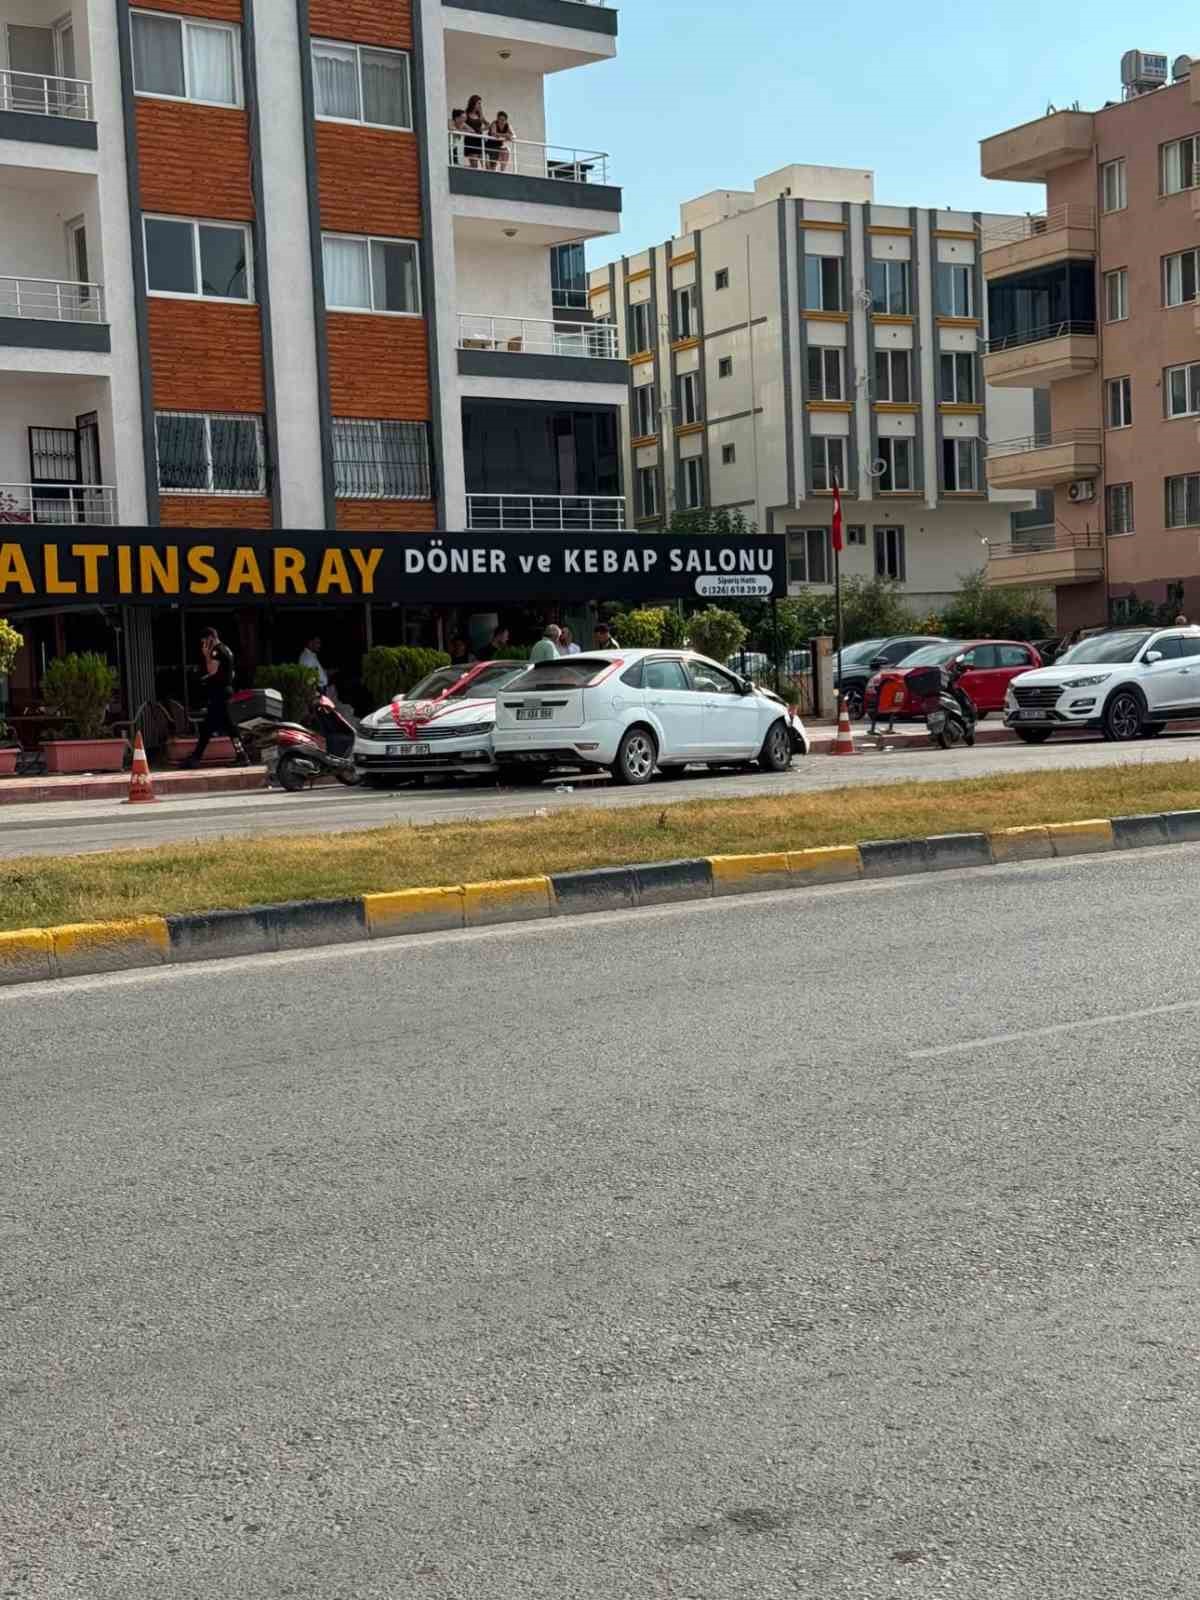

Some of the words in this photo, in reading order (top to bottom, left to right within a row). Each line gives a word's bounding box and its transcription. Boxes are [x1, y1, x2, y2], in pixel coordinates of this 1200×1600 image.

[0, 543, 384, 594] ALTINSARAY
[404, 539, 507, 574] DÖNER
[518, 553, 552, 573] ve
[563, 548, 659, 573] KEBAP
[669, 548, 774, 573] SALONU
